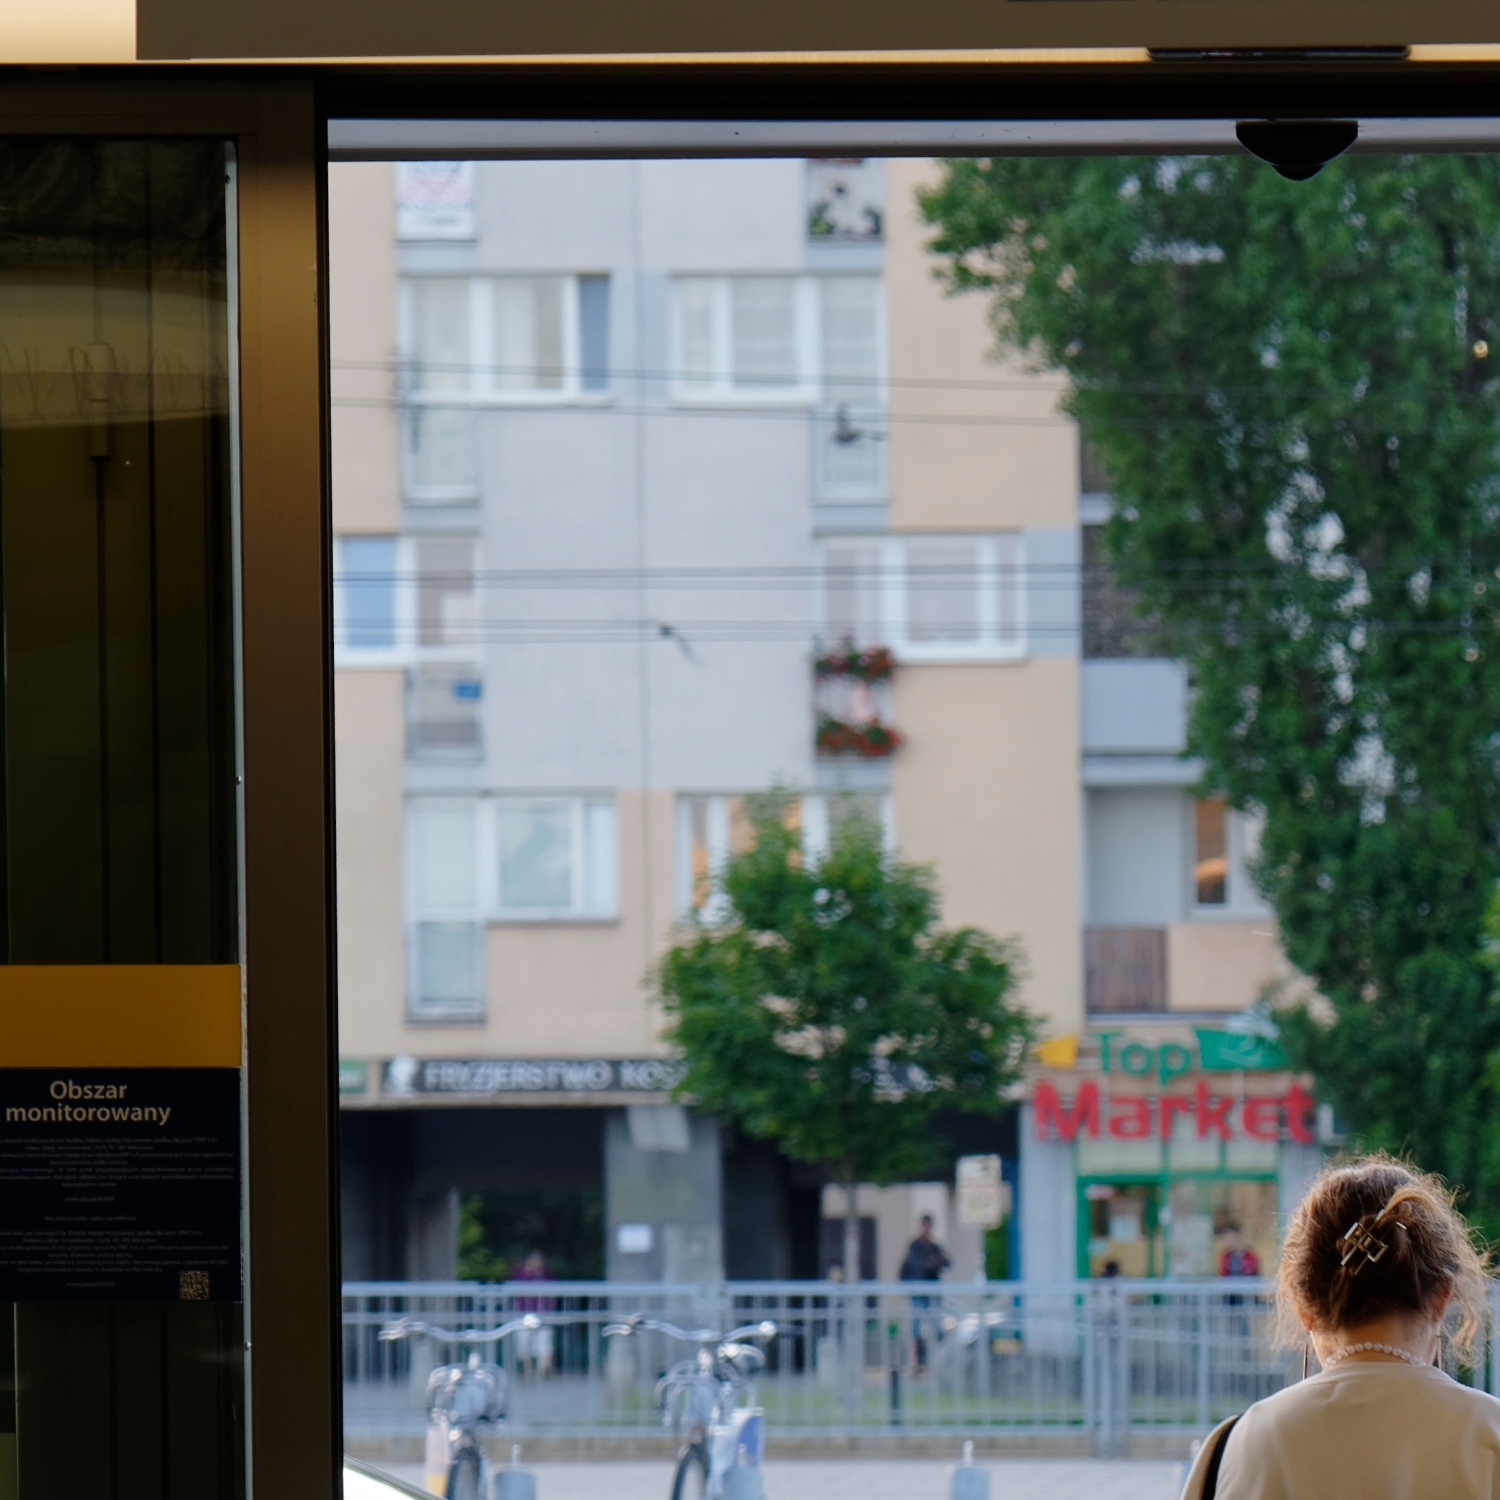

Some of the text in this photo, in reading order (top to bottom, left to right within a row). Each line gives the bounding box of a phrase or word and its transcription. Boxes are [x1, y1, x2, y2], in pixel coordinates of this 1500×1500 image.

[1096, 1031, 1191, 1086] Top
[49, 1080, 128, 1100] Obszar
[5, 1102, 172, 1127] monitorowany
[1033, 1078, 1314, 1143] Market
